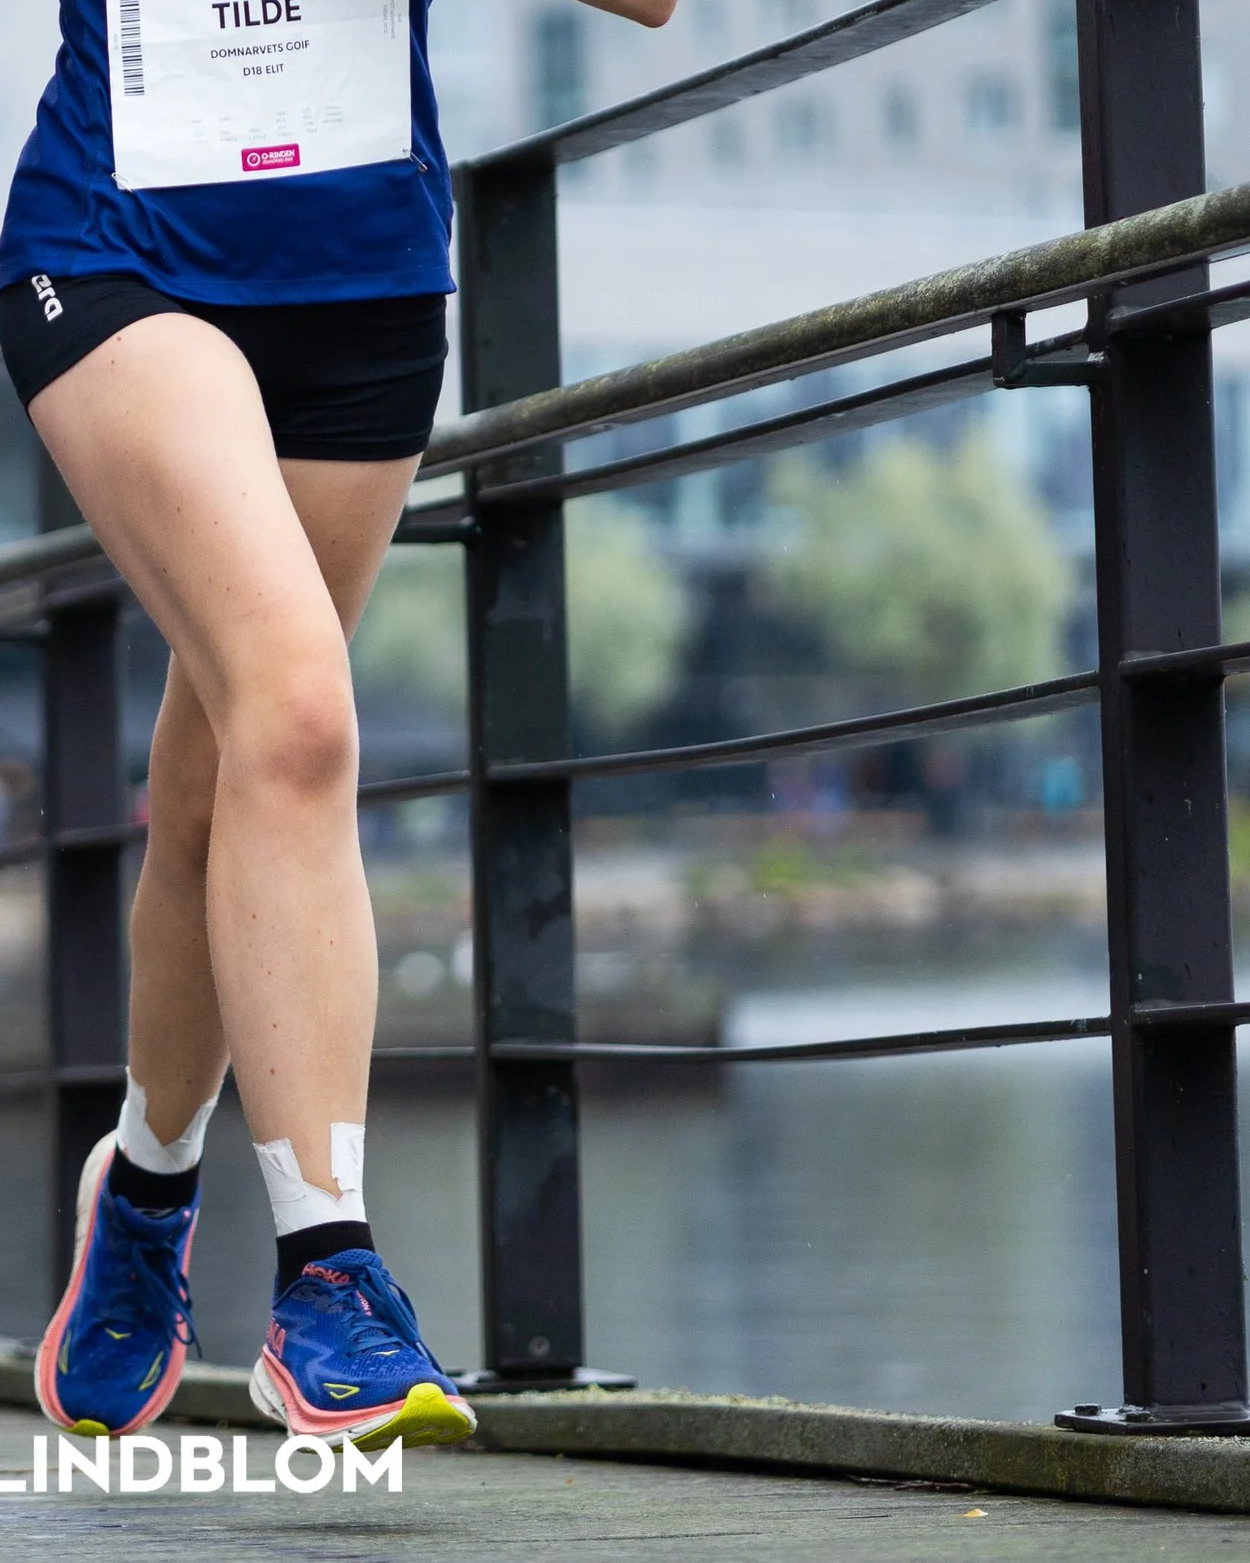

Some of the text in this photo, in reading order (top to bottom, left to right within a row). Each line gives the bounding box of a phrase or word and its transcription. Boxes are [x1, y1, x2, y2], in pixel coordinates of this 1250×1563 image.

[210, 39, 310, 59] DOMNARVETS GOIF
[242, 63, 285, 77] D18 ELIT
[261, 149, 295, 160] O-RINGEN
